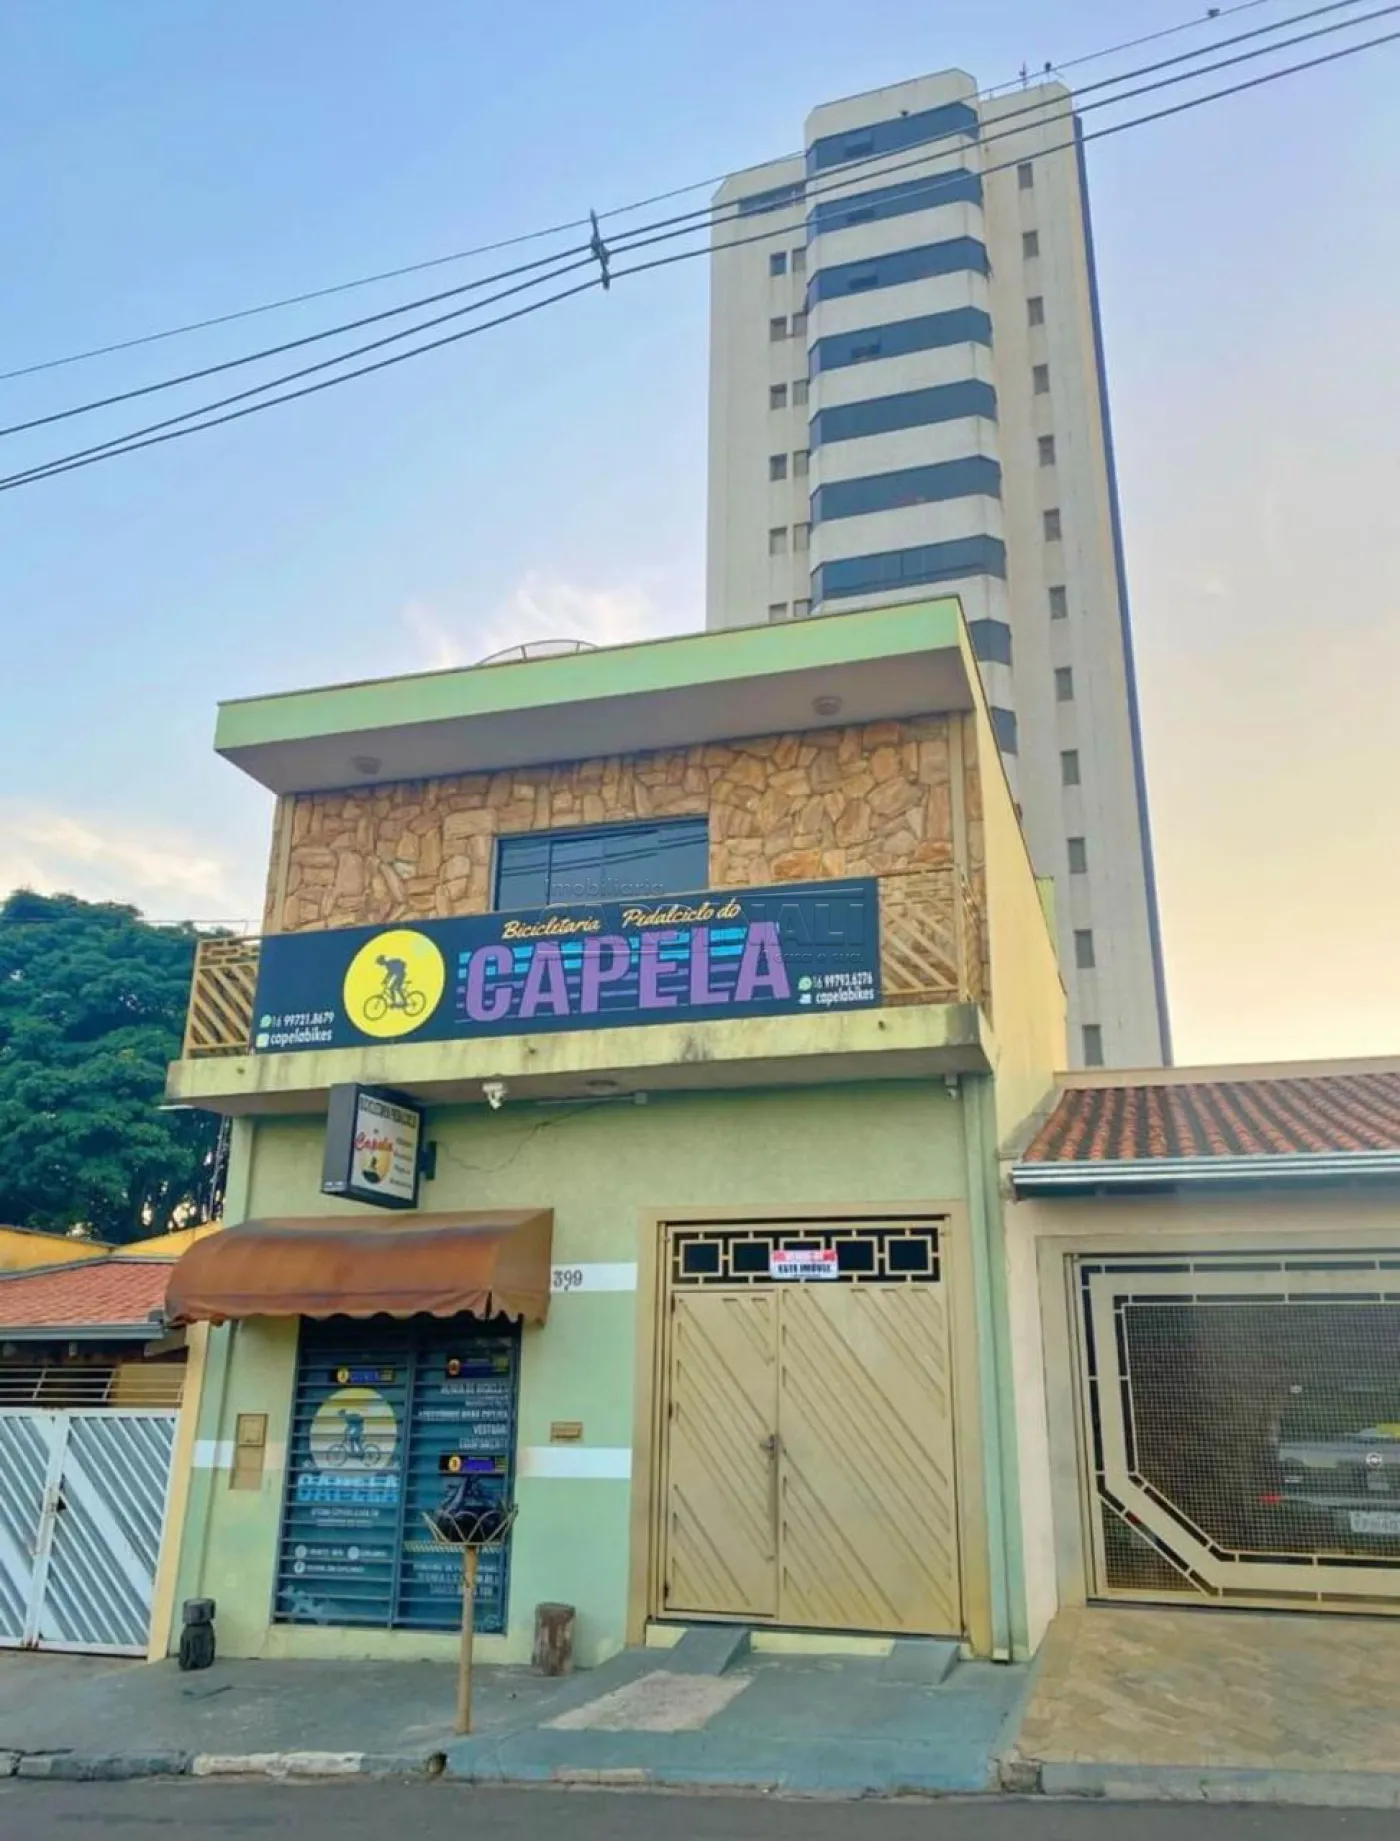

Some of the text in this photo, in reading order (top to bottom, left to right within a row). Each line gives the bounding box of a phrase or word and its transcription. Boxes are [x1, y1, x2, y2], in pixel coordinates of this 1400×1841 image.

[501, 897, 742, 940] Bicicletaria Pedalciclo do
[465, 921, 791, 1022] CAPELA
[815, 986, 875, 1008] capelabikes
[270, 1026, 333, 1048] capelabikes
